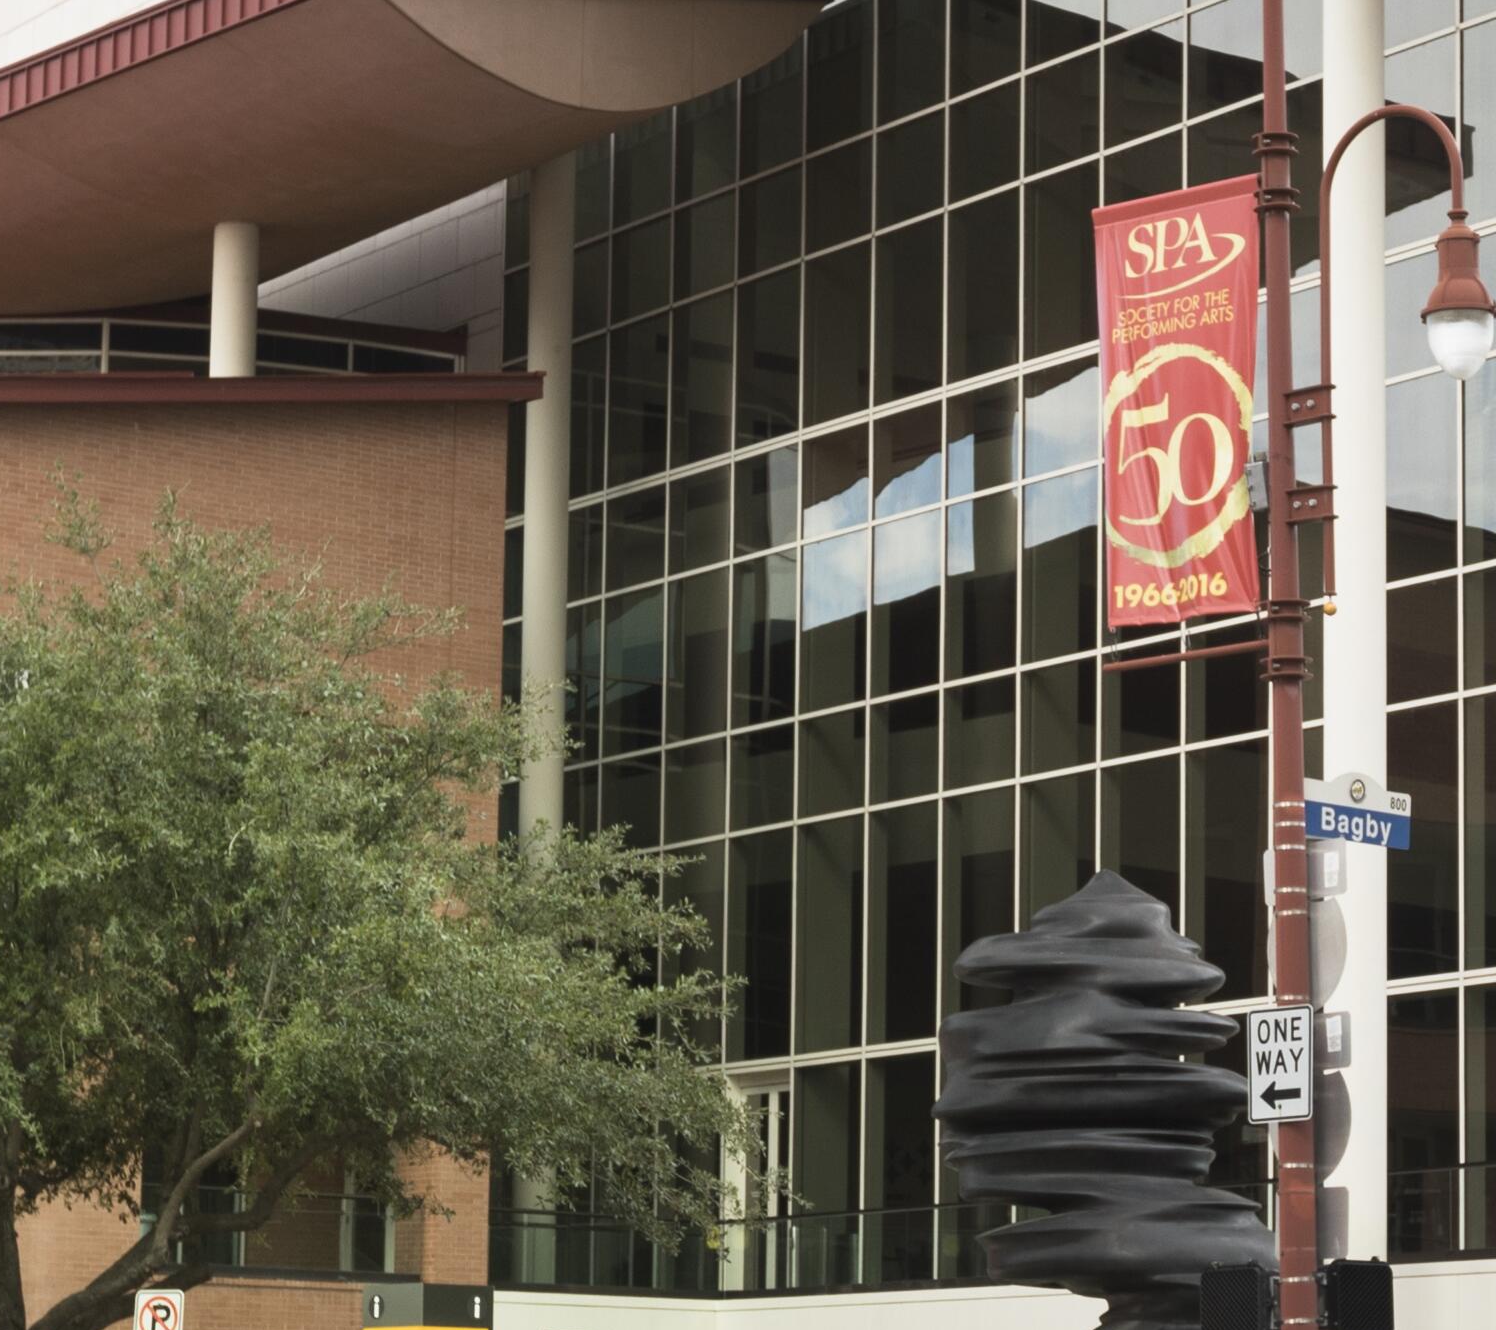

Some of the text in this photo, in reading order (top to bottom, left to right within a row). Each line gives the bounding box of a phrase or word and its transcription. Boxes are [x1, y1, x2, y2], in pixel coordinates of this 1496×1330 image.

[1125, 212, 1218, 278] SPA
[1112, 306, 1234, 344] PERFORMING ARTS
[1118, 289, 1230, 327] SOCIETY FOR THE
[1118, 392, 1234, 526] 50
[1114, 572, 1228, 608] 1966-2016
[1390, 797, 1407, 812] 800
[1321, 806, 1392, 846] Bagby
[1257, 1017, 1302, 1044] ONE
[1256, 1047, 1304, 1075] WAY
